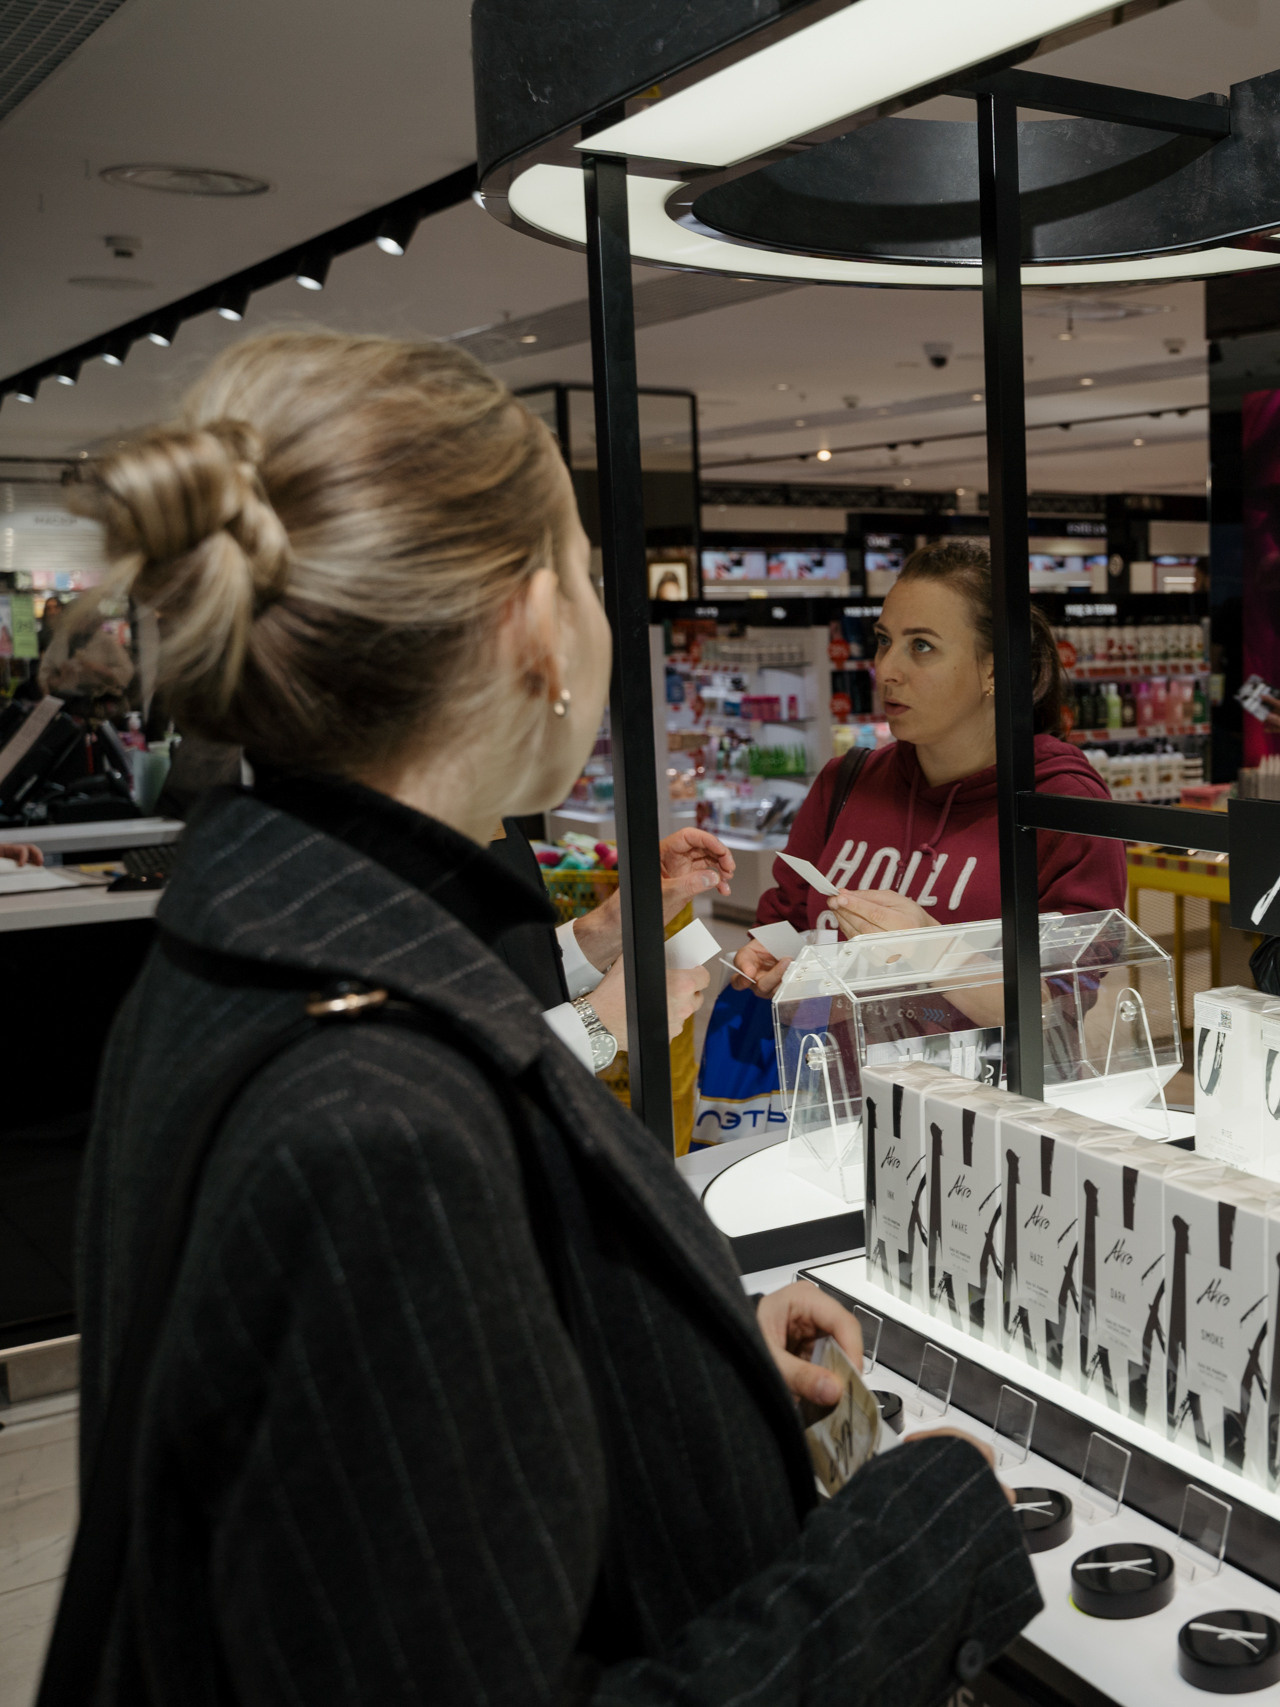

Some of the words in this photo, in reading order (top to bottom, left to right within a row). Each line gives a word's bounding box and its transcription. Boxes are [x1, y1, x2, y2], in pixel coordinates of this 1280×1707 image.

[951, 1219, 968, 1235] AWAKE
[1030, 1250, 1043, 1267] HAZE
[1110, 1288, 1126, 1304] DARK
[1201, 1329, 1224, 1349] SMOKE
